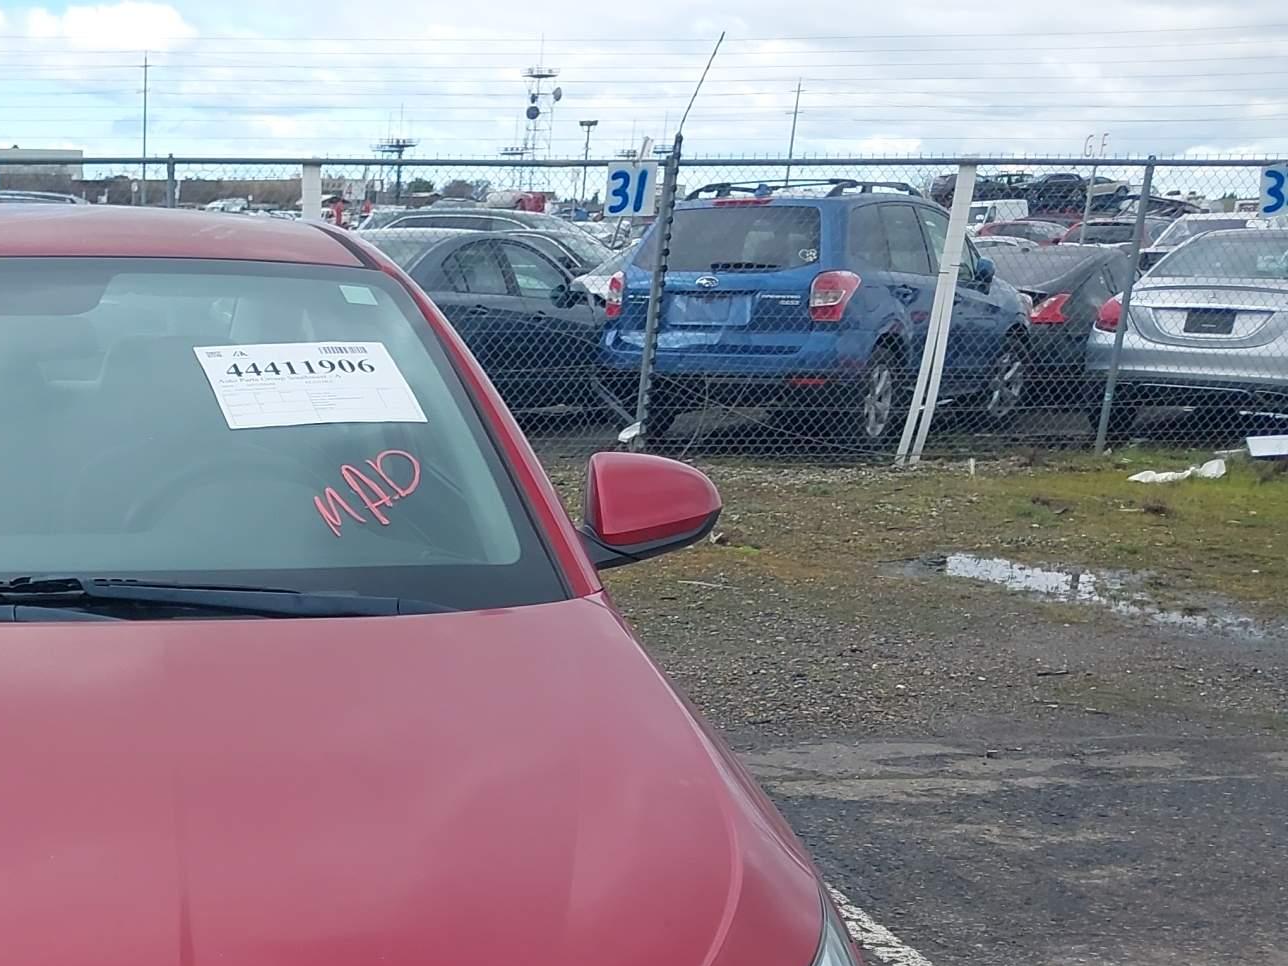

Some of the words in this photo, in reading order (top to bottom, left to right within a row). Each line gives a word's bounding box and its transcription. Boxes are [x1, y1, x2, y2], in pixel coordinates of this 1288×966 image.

[608, 169, 649, 213] 31
[1263, 169, 1288, 213] 3
[225, 358, 376, 378] 44411906
[313, 449, 422, 538] MAD
